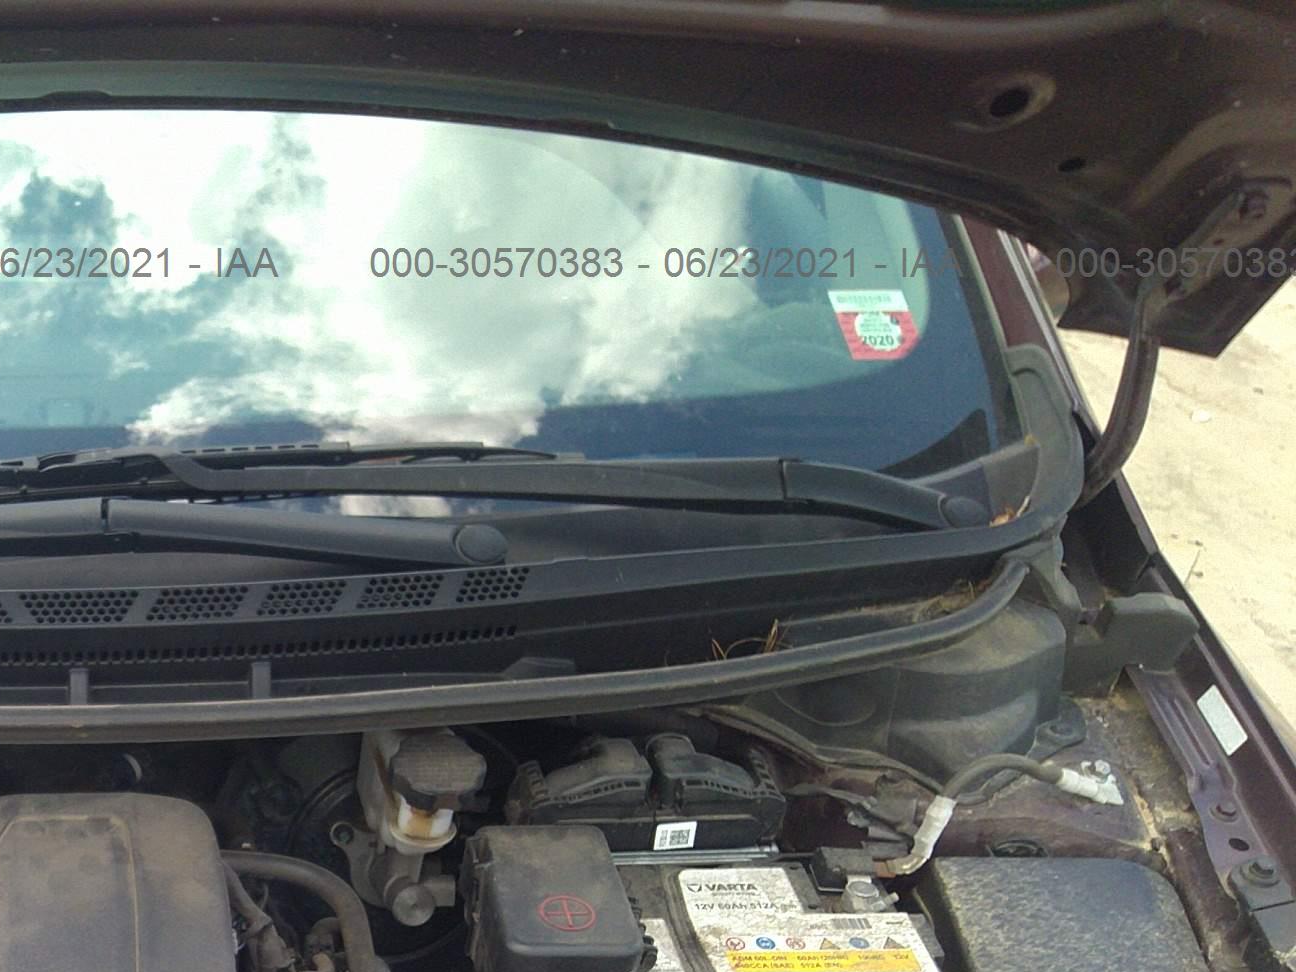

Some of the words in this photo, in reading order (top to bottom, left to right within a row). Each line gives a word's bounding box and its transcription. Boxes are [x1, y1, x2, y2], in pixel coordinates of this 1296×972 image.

[863, 334, 895, 346] 2020
[705, 883, 758, 891] VARTA
[694, 903, 714, 911] 12V
